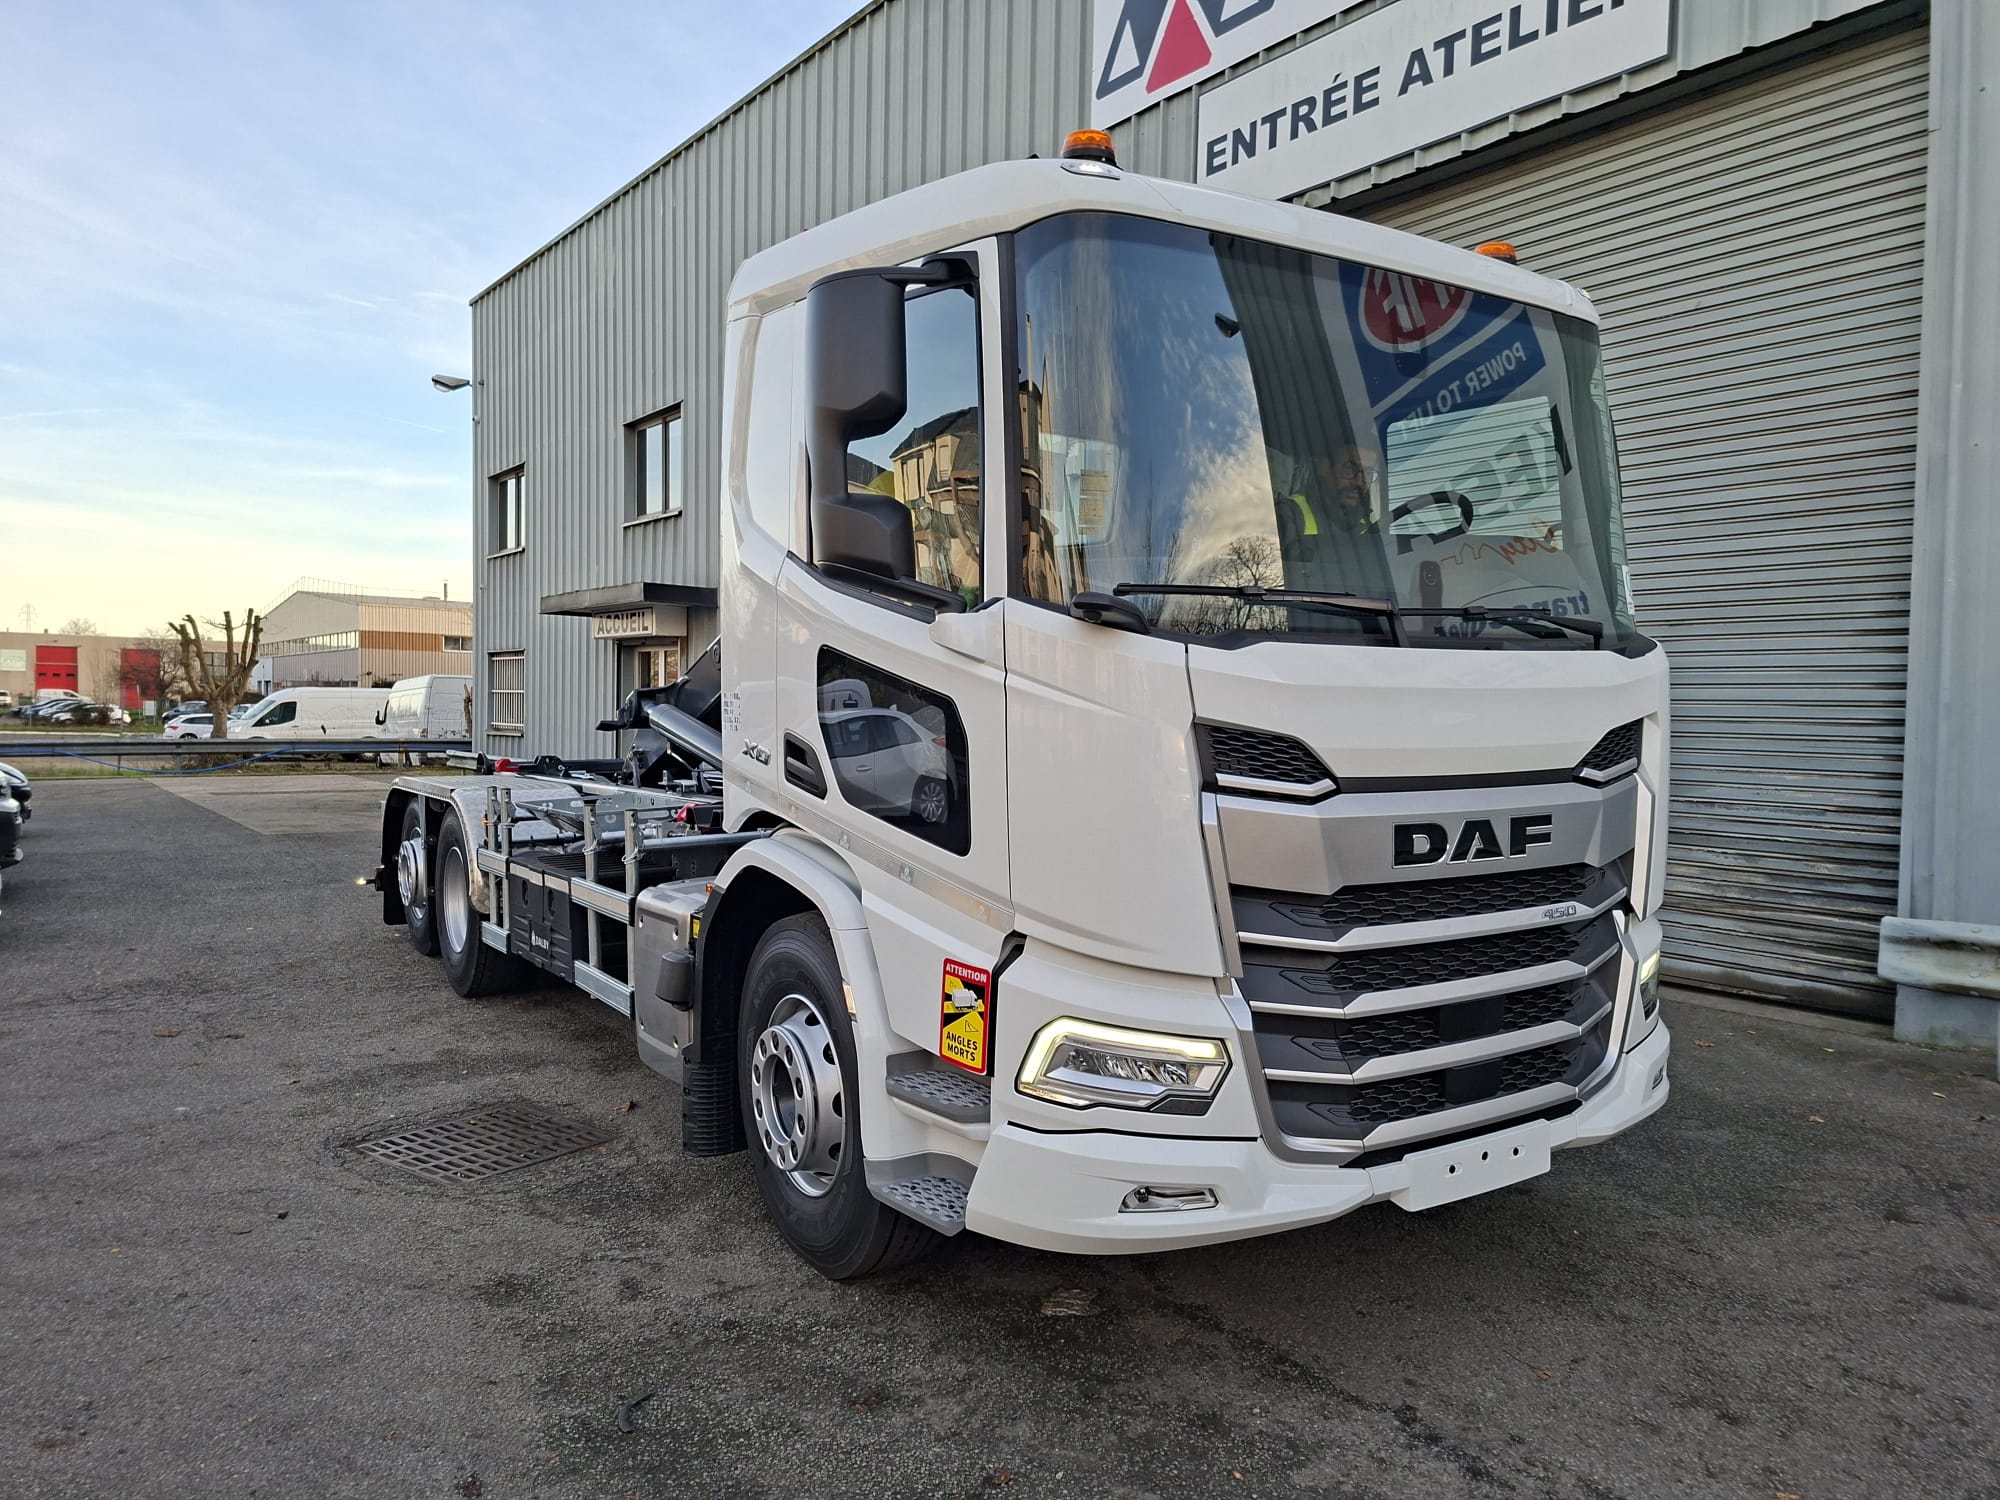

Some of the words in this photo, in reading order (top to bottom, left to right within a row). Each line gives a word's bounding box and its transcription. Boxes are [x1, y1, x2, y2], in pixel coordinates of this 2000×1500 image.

[1206, 65, 1381, 178] ENTRÉE
[1397, 0, 1625, 97] ATELIE
[597, 611, 649, 635] ACCUEIL
[1392, 813, 1553, 869] DAF
[1542, 904, 1578, 920] 450
[945, 962, 988, 983] ATTENTION
[945, 1031, 978, 1051] ANGLES
[947, 1042, 976, 1062] MORTS
